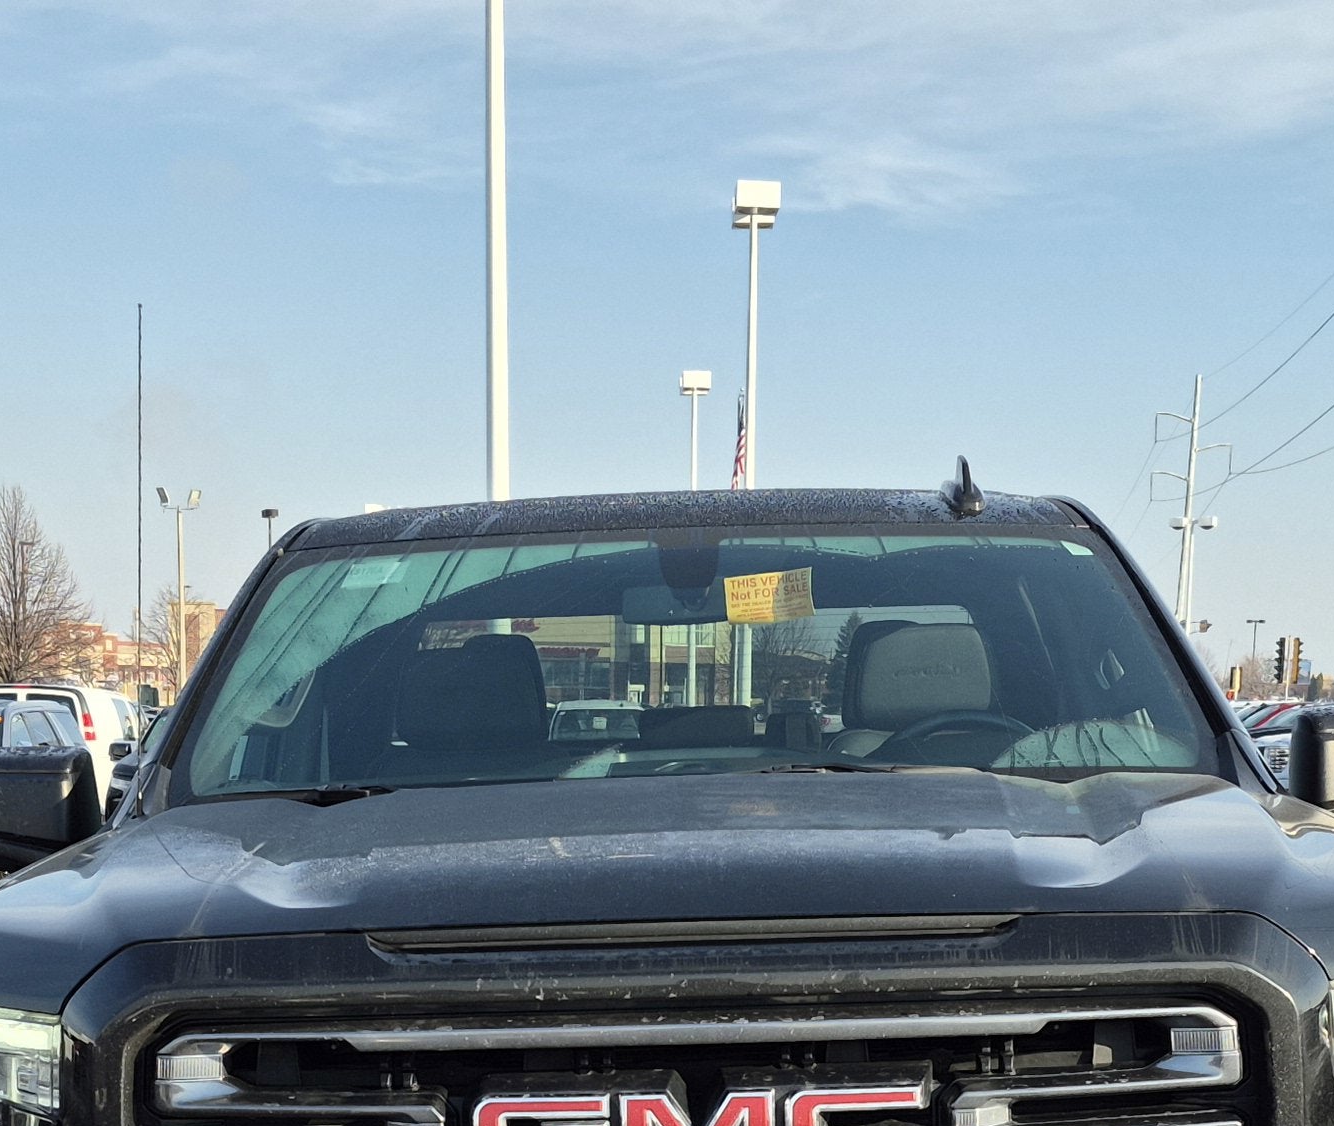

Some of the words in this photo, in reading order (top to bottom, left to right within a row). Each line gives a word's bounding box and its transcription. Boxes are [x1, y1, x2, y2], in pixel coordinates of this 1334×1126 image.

[730, 577, 757, 590] THIS
[760, 570, 807, 587] VEHICLE
[730, 590, 752, 602] Not
[754, 587, 780, 600] FOR
[783, 583, 808, 596] SALE
